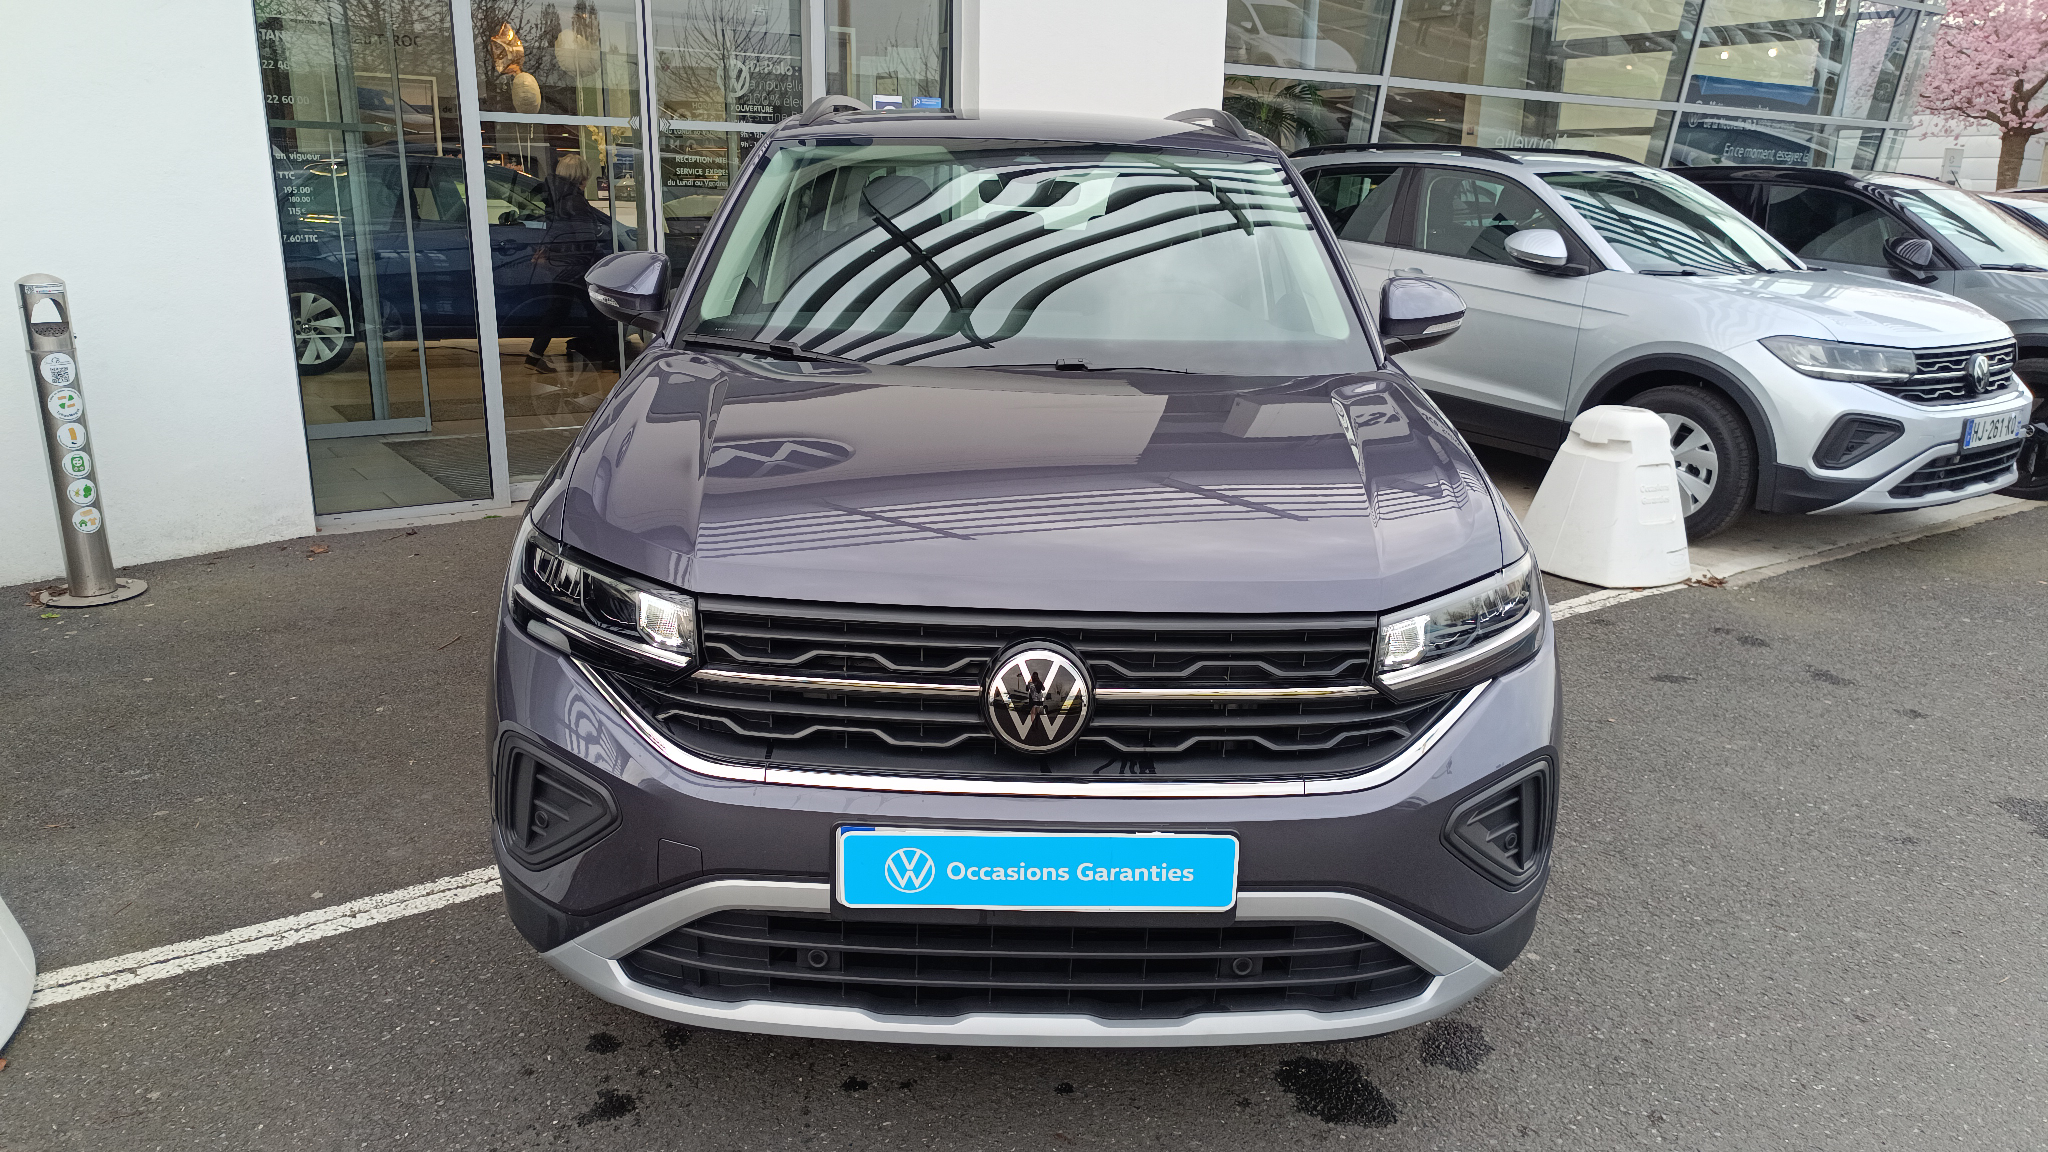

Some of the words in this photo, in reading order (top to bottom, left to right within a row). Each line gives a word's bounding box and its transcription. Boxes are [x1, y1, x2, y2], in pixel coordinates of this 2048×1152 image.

[266, 94, 280, 104] 22
[281, 95, 295, 104] 60
[747, 93, 780, 106] 100%
[289, 152, 321, 162] vigueur
[1724, 143, 1735, 156] En
[1734, 146, 1745, 158] ce
[1776, 150, 1802, 164] essayez
[278, 171, 296, 180] TTC
[667, 178, 676, 186] du
[304, 234, 319, 243] TTC
[946, 861, 1070, 882] Occasions
[1076, 862, 1195, 883] Garanties
